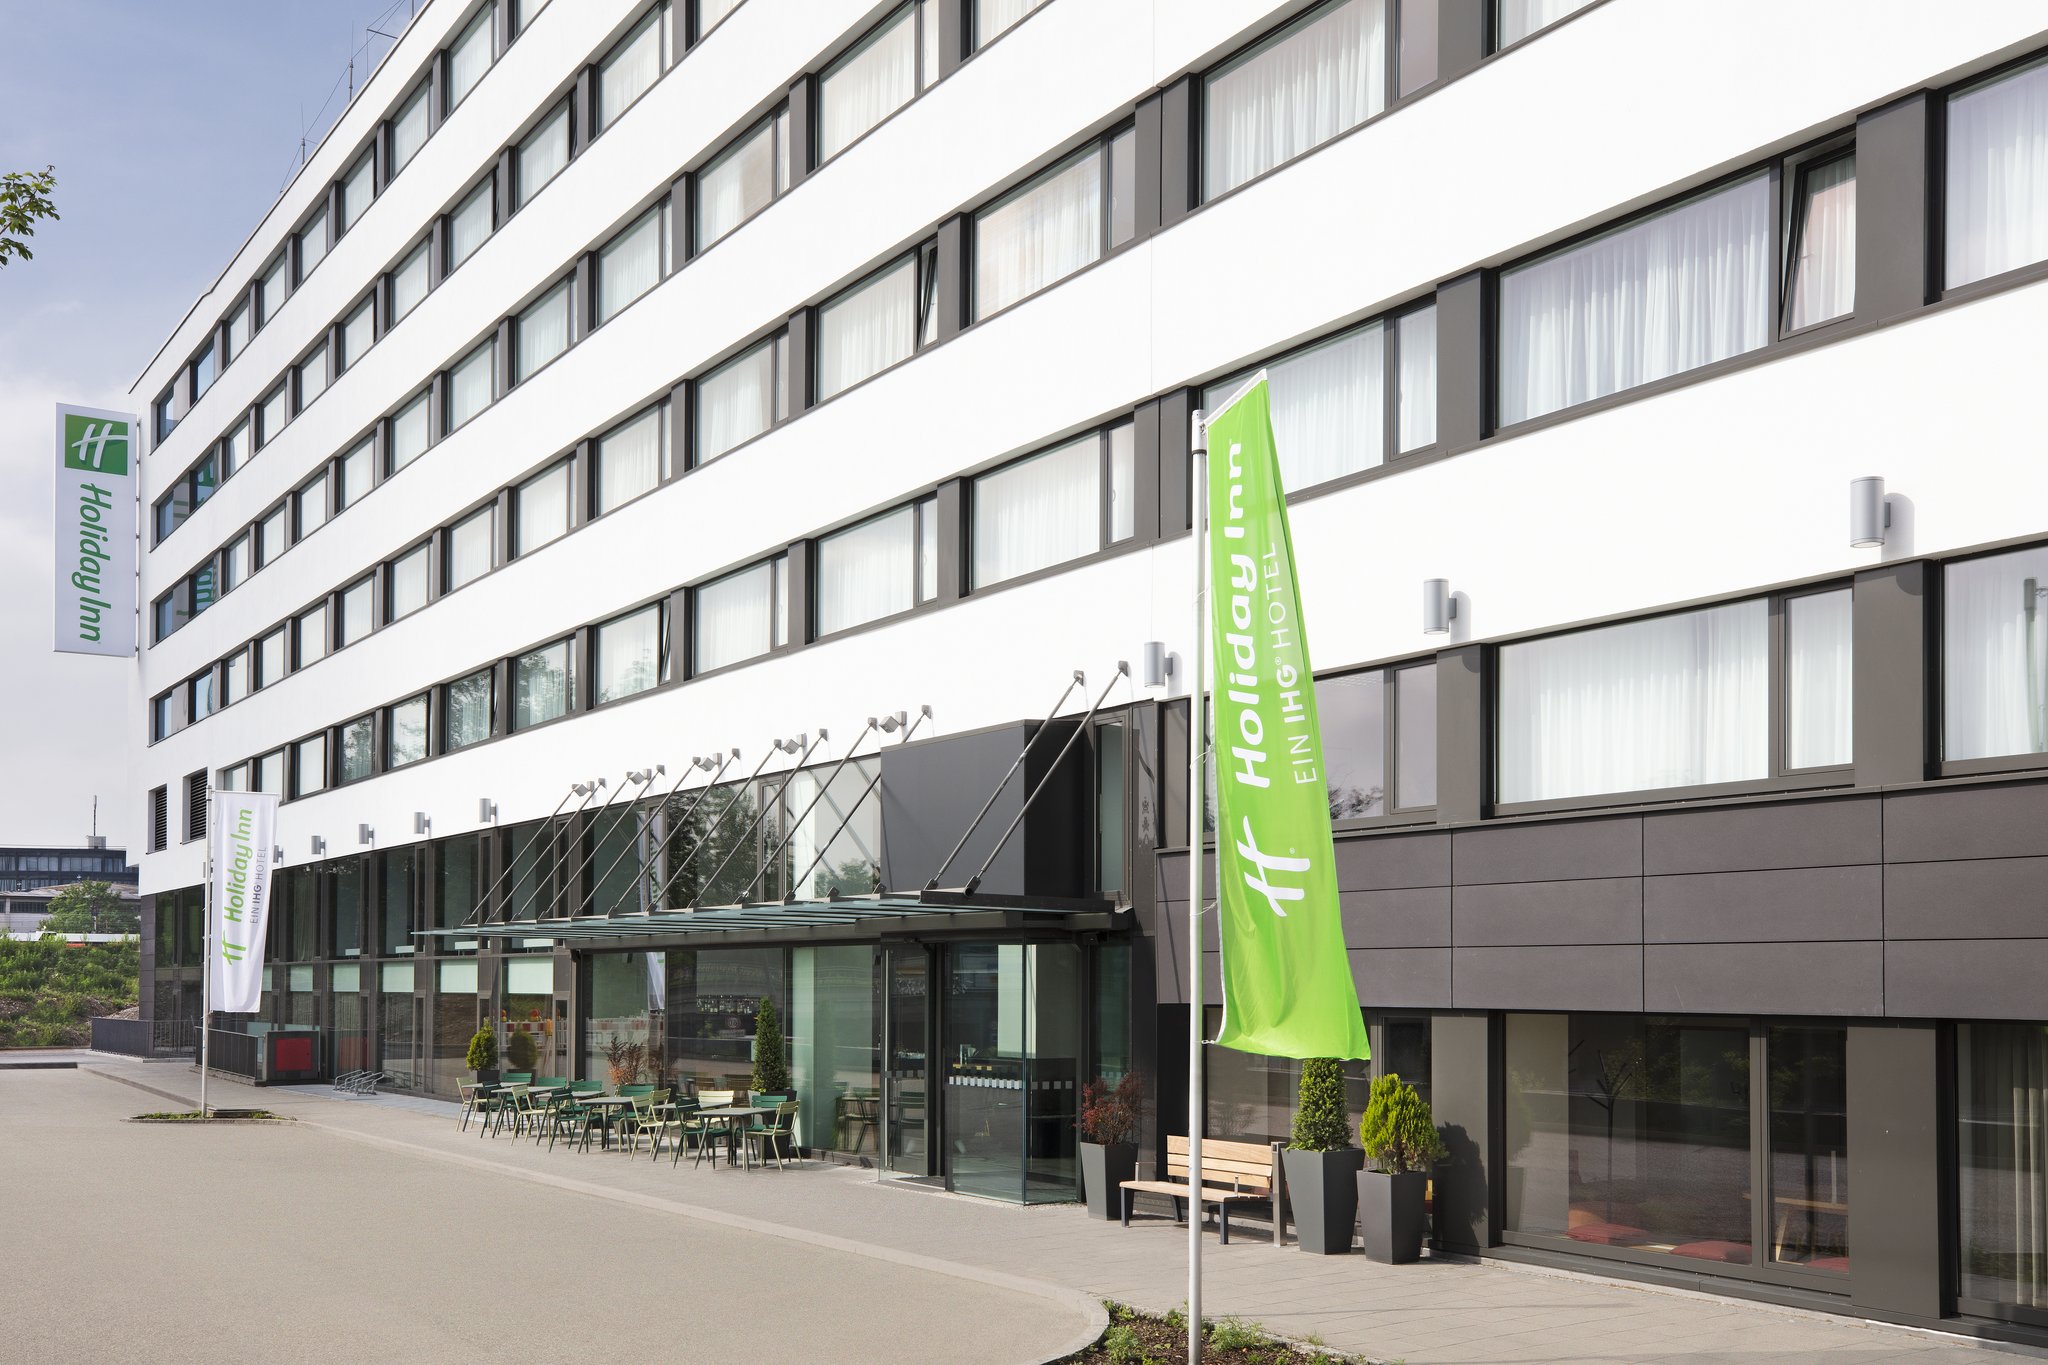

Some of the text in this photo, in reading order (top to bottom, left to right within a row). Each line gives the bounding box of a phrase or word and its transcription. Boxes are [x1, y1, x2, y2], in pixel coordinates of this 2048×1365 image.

[71, 483, 112, 642] Holiday Inn
[1224, 443, 1270, 788] Holiday Inn
[1262, 542, 1291, 648] HOTEL
[1287, 734, 1317, 784] EIN
[224, 808, 253, 923] Holiday Inn
[250, 847, 267, 925] EIN IHG HOTEL
